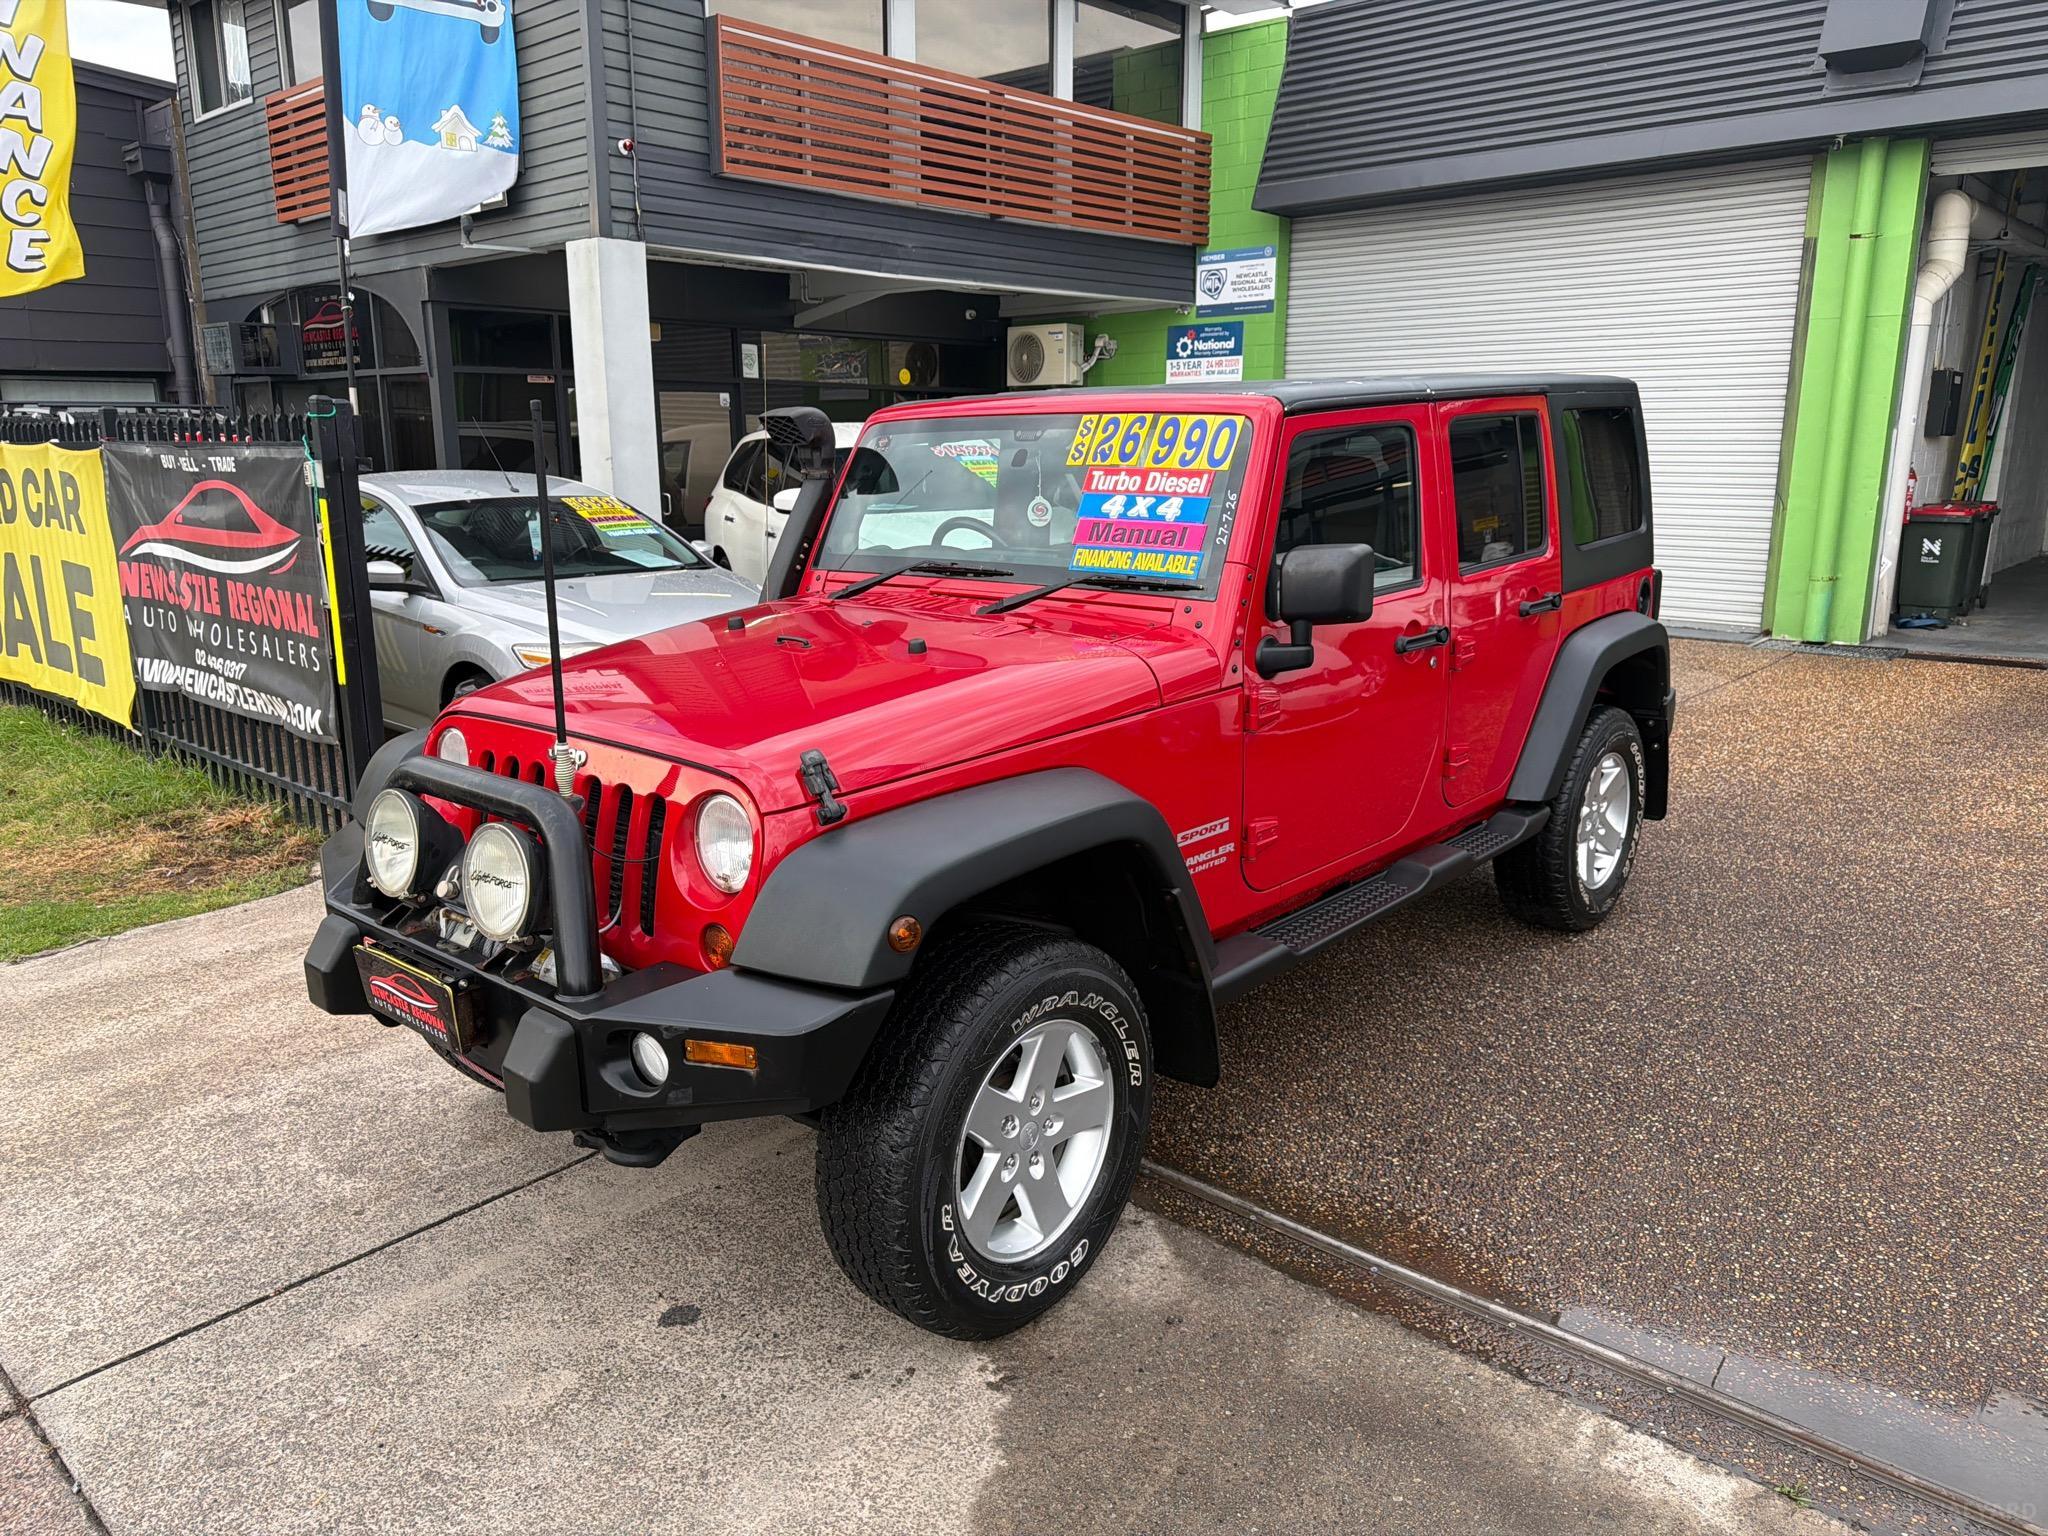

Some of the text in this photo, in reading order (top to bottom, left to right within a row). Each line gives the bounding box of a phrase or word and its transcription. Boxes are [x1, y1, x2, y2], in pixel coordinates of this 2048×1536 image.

[1232, 284, 1271, 293] WHOLESALERS
[1236, 271, 1268, 279] NEWCASTLE
[1193, 336, 1235, 351] National
[1170, 360, 1202, 371] 1-5 YEAR
[1206, 360, 1214, 369] 24
[1214, 359, 1223, 368] HR
[160, 454, 176, 469] BUY
[208, 456, 236, 472] TRADE
[1090, 470, 1209, 494] Turbo Diesel
[21, 467, 86, 535] CAR
[1087, 522, 1189, 547] Manual
[1072, 548, 1199, 574] FINANCING AVAILABLE
[0, 551, 106, 688] ALE
[124, 604, 177, 633] AUTO
[226, 579, 319, 638] REGIONAL
[195, 648, 207, 667] 02
[223, 659, 248, 681] 0317
[1622, 742, 1646, 878] GOODYEAR
[1180, 821, 1227, 843] SPORT
[370, 983, 447, 1034] NEWCASTLE REGIONAL
[374, 996, 448, 1043] AUTO WHOLESALERS
[1010, 990, 1143, 1087] WRANGLER
[941, 1203, 1090, 1304] GOODYEAR
